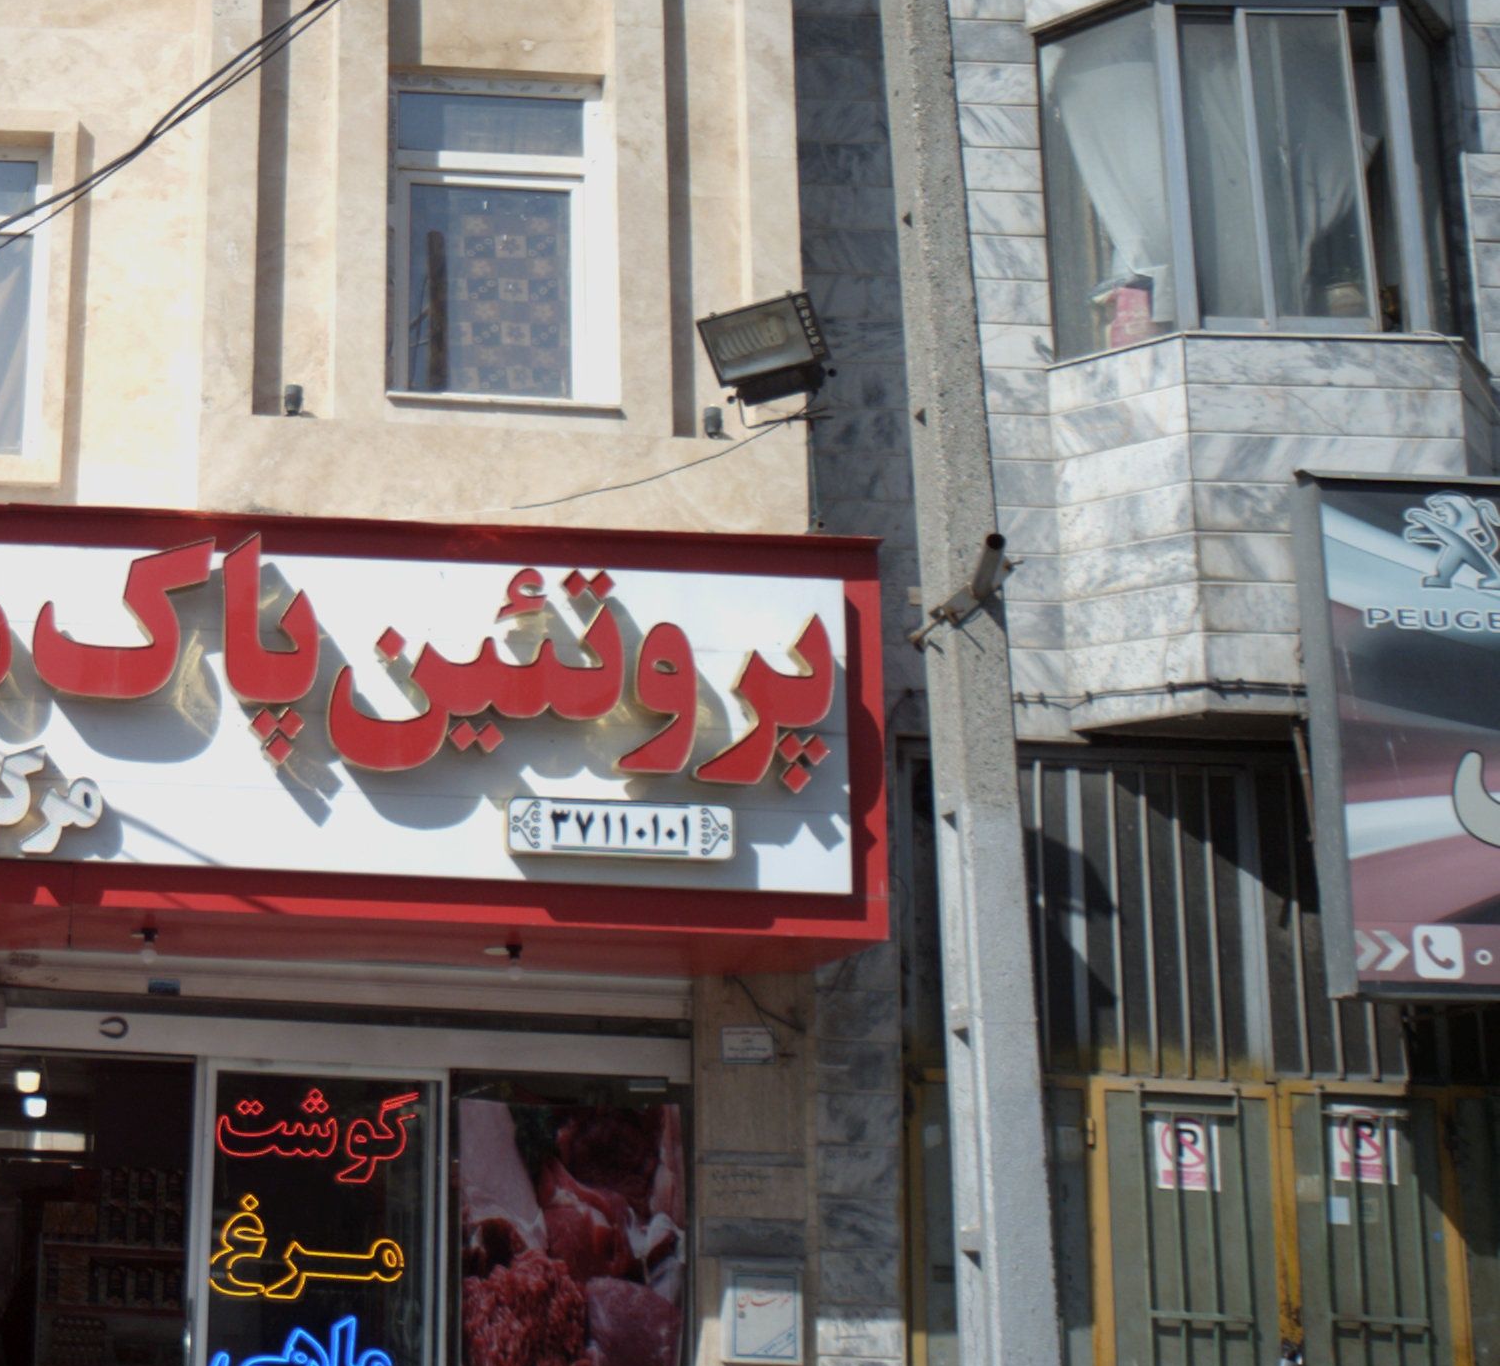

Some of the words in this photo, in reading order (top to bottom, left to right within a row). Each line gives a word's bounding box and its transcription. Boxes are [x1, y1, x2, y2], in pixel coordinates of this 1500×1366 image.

[33, 532, 320, 765] پاک
[328, 567, 834, 794] پروتئین
[550, 809, 691, 847] ۳۷۱۱۰۱۰۱
[215, 1087, 420, 1184] گوشت
[208, 1193, 405, 1299] مرغ
